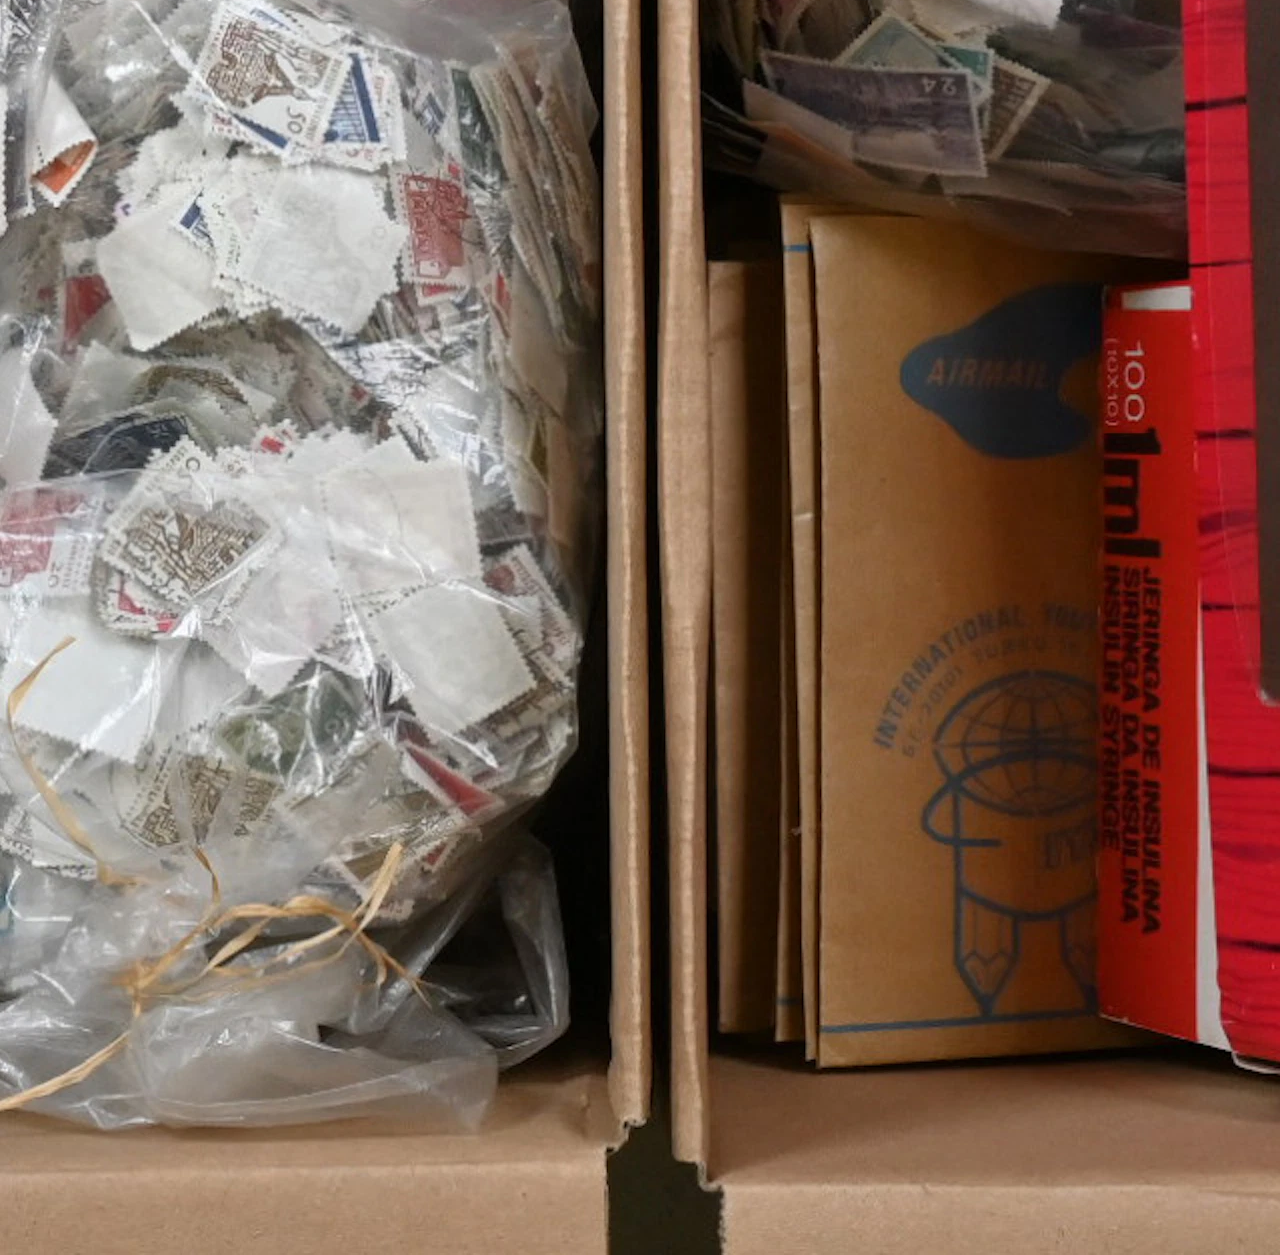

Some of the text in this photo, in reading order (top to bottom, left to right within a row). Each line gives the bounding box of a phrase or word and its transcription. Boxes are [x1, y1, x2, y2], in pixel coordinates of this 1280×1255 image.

[285, 105, 308, 135] 50
[921, 76, 958, 96] 24
[925, 357, 1051, 390] AIRMAIL
[1123, 340, 1146, 423] 100
[873, 604, 1026, 749] INTERNATIONAL
[1103, 565, 1120, 851] INSULIN SYRINGE
[1121, 566, 1140, 925] SIRINGA DA INSULINA
[1142, 567, 1161, 935] JERINGA DE INSULINA
